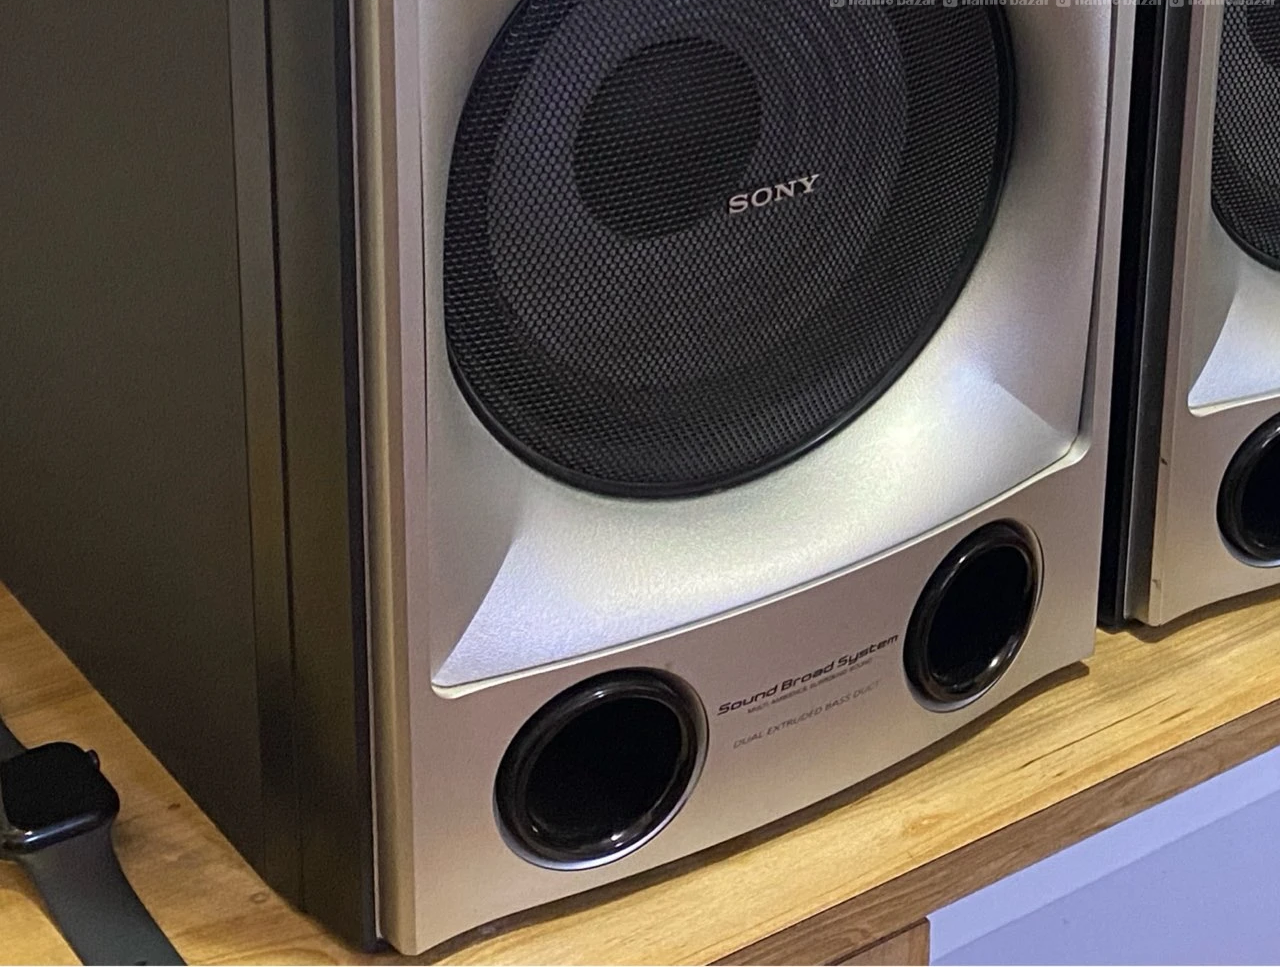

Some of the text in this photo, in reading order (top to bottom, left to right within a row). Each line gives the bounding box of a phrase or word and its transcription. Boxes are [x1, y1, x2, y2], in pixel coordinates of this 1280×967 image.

[728, 173, 820, 214] SONY
[717, 634, 899, 716] Sound Broad System
[733, 731, 764, 749] DUAL
[766, 707, 823, 736] EXTRUDED
[824, 694, 850, 711] BASS
